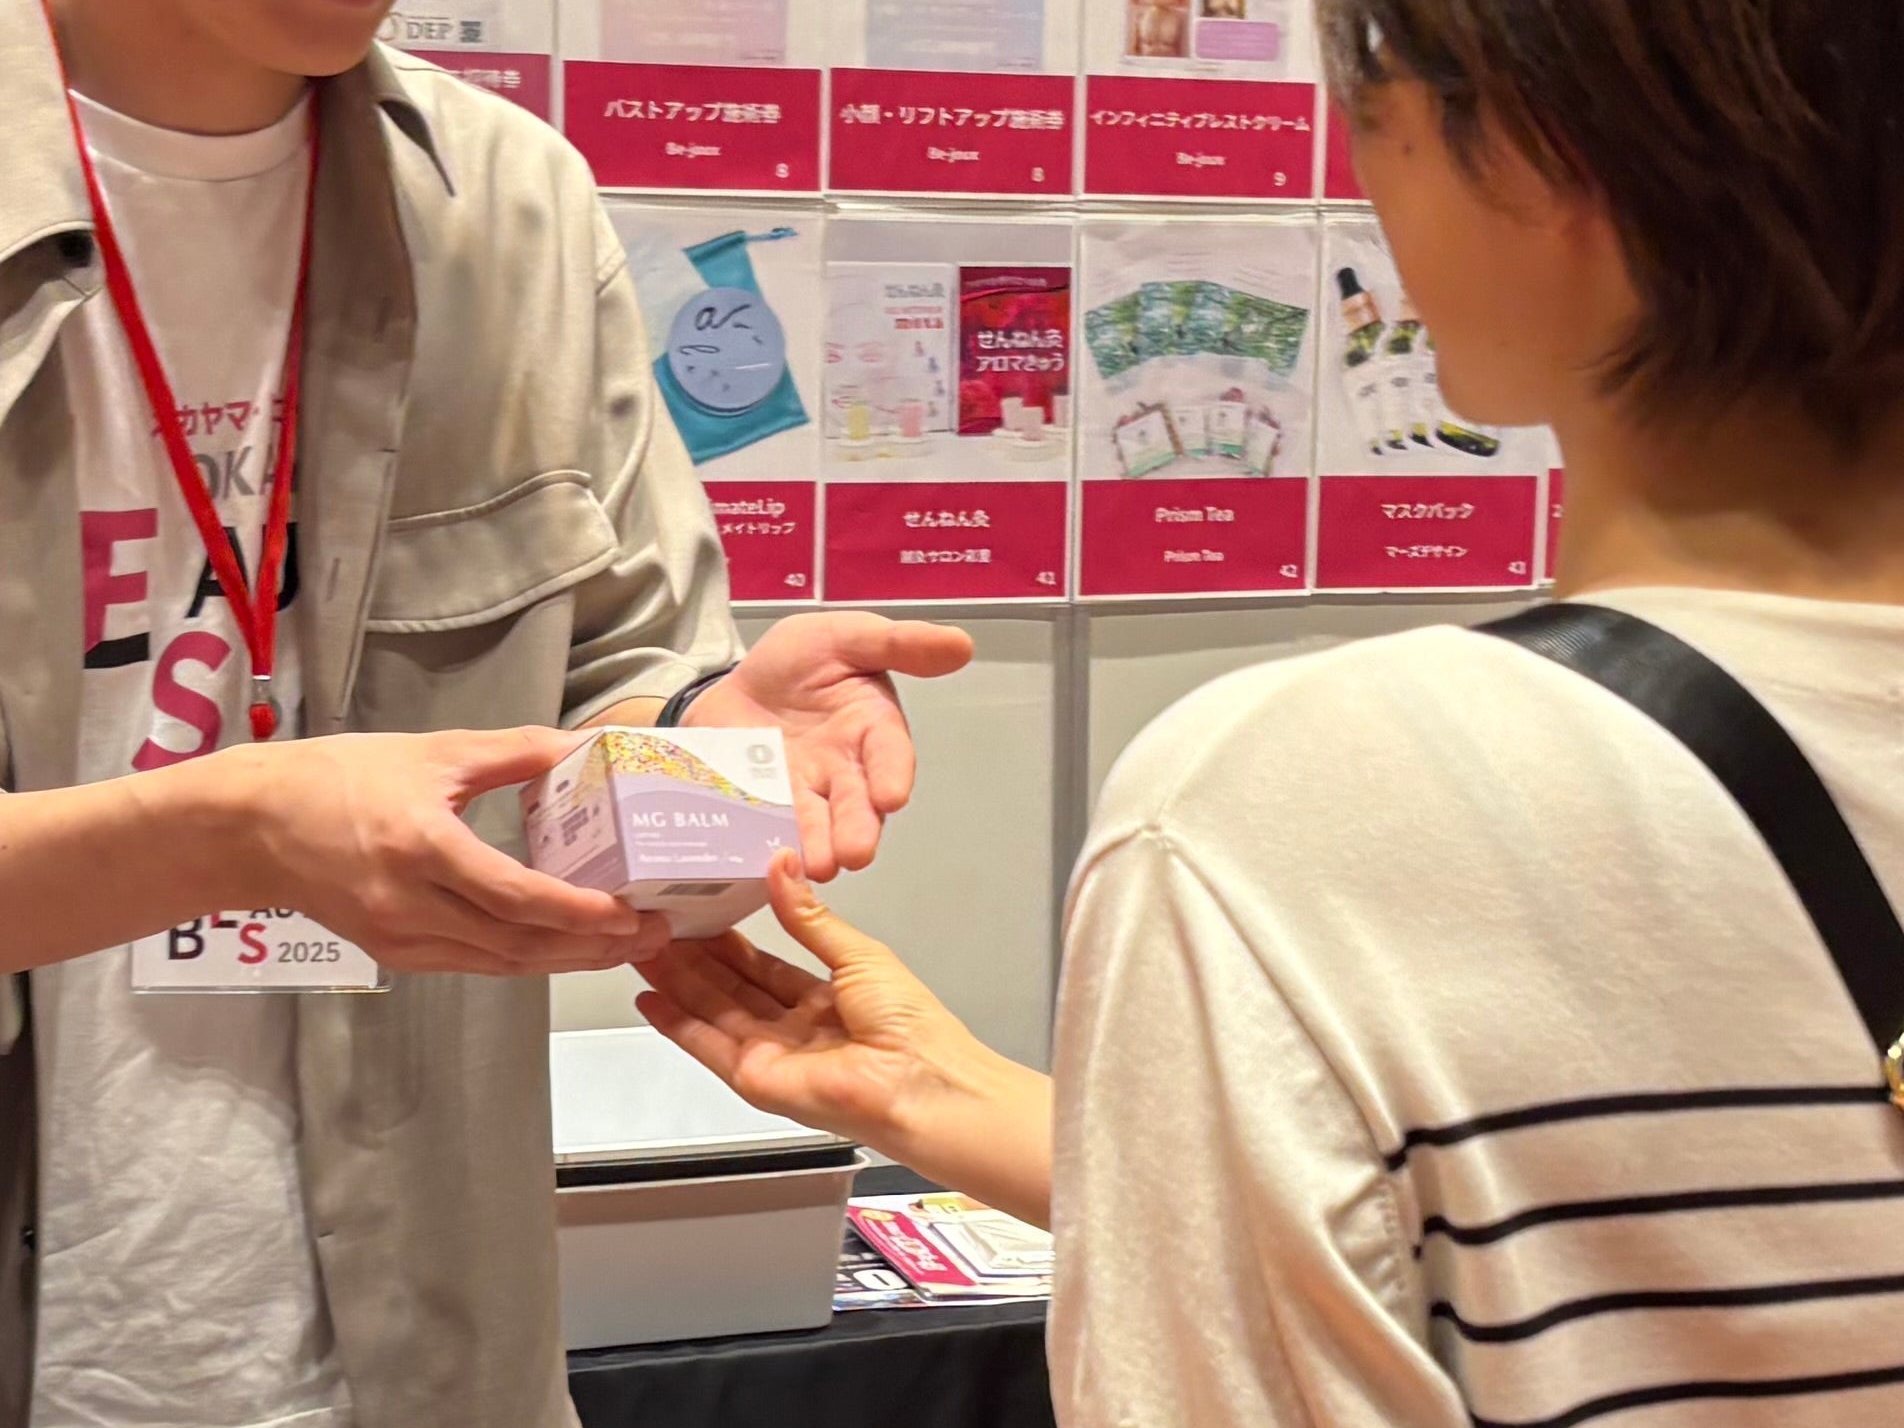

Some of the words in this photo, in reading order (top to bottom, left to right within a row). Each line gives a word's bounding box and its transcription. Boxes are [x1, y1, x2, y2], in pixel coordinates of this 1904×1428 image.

[976, 329, 1065, 350] せんねん灸
[903, 510, 992, 528] せんねん灸
[1155, 507, 1204, 523] Prism
[1206, 506, 1235, 522] Tea
[632, 811, 667, 828] MG
[673, 812, 730, 828] BALM
[277, 941, 341, 963] 2025
